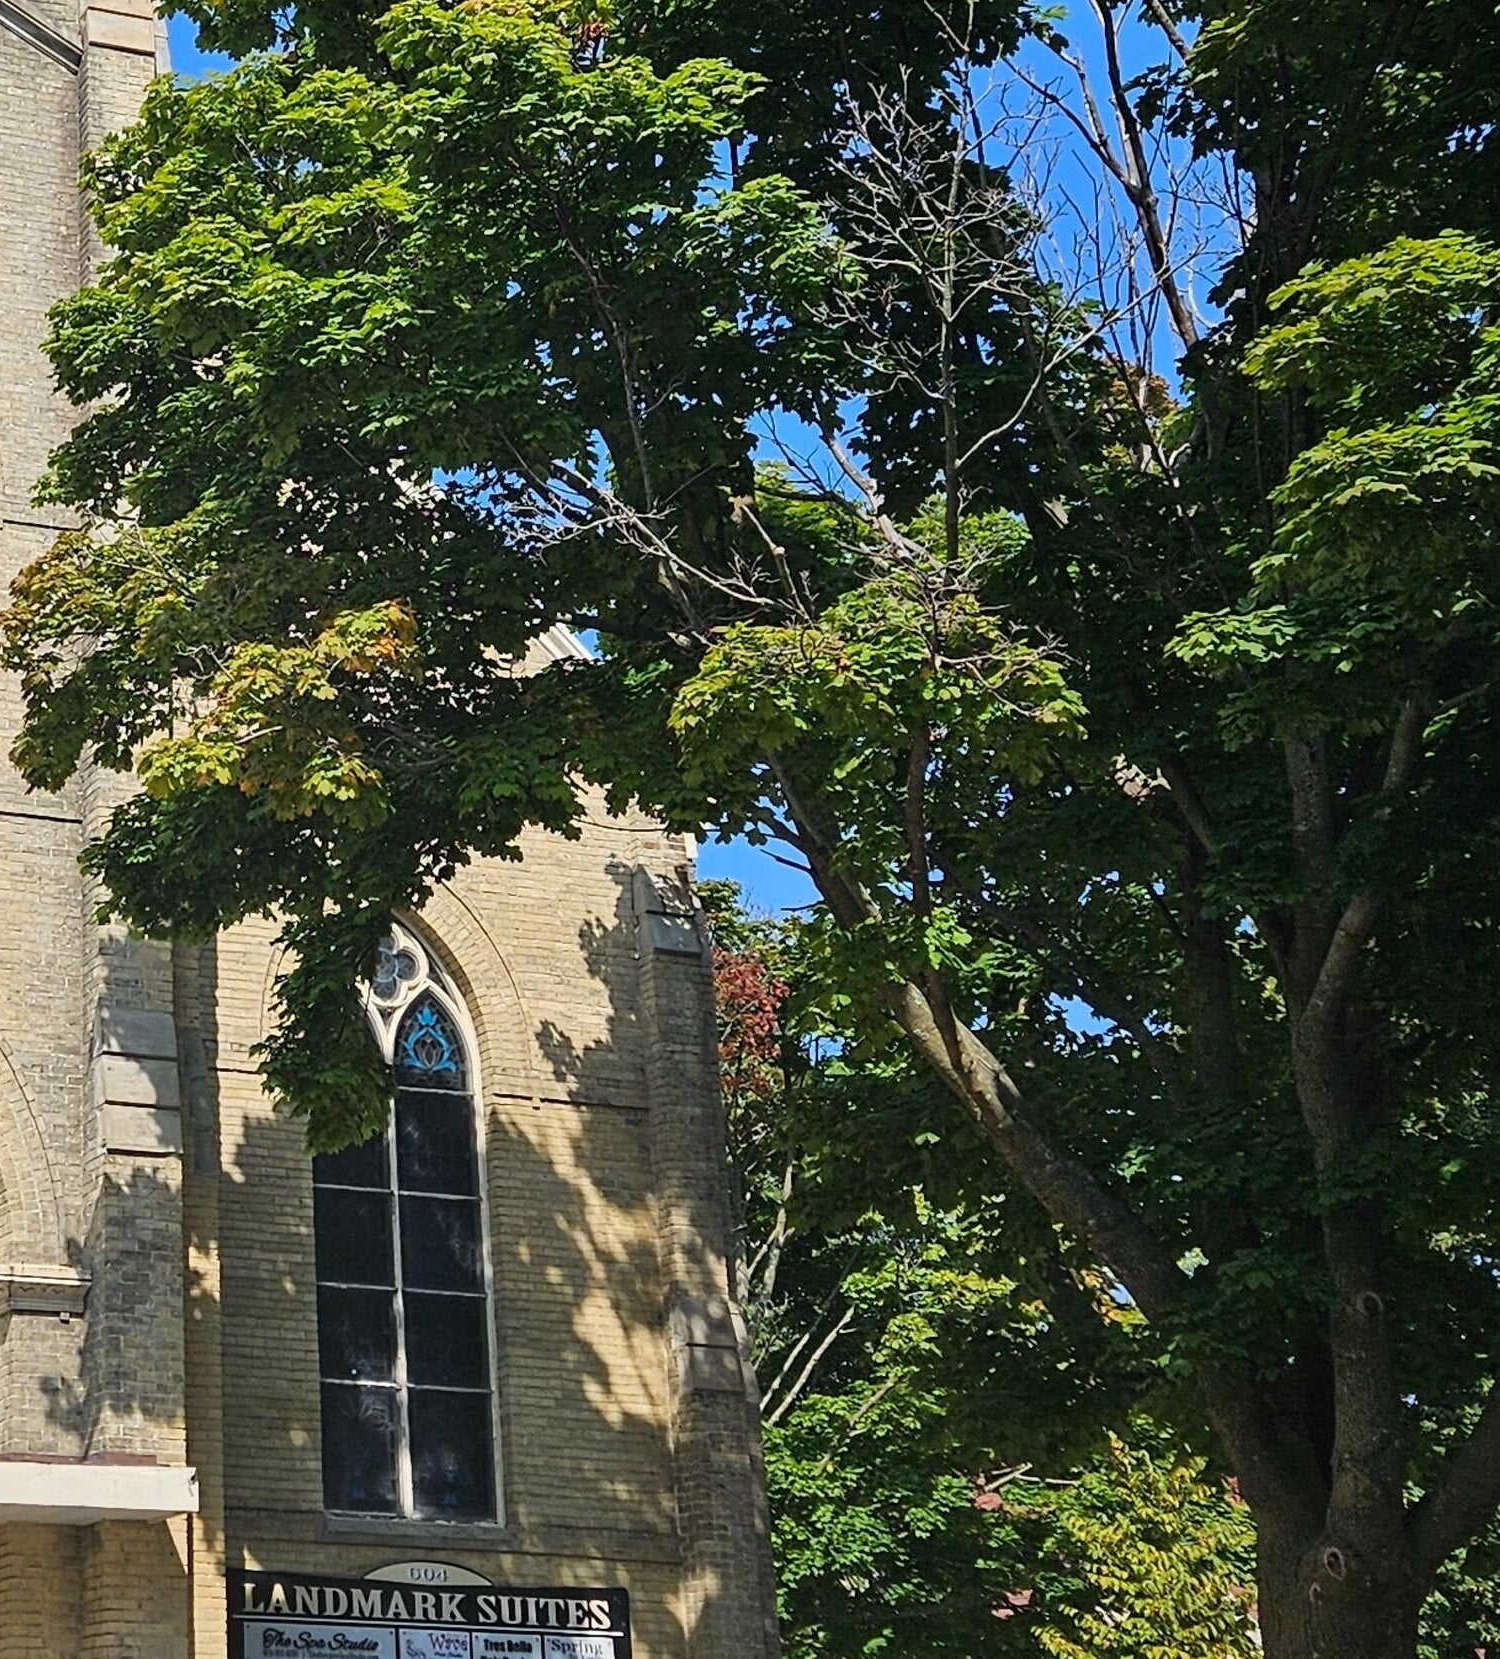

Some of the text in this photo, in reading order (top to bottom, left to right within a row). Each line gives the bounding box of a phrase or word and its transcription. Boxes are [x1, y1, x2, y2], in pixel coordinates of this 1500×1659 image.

[410, 1568, 448, 1582] 604
[244, 1583, 611, 1629] LANDMARK SUITES
[263, 1628, 379, 1651] The Spa Studio
